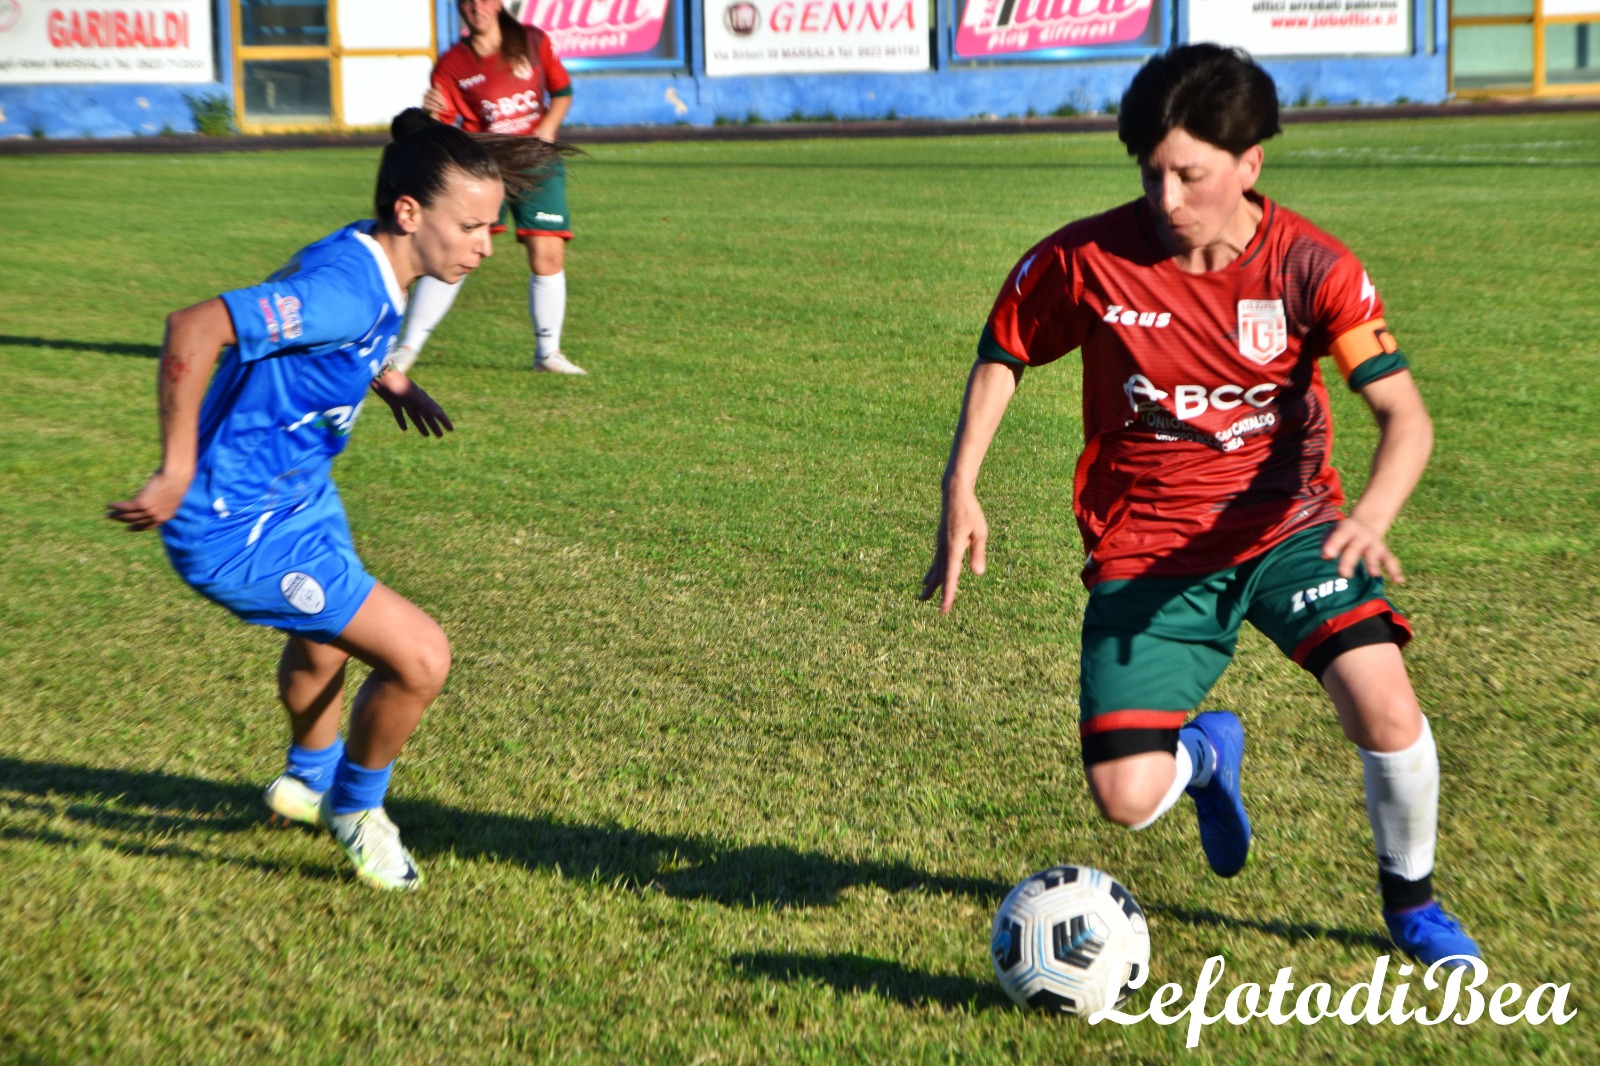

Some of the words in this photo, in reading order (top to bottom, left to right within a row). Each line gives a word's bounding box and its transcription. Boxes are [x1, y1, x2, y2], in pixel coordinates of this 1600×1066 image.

[47, 9, 189, 49] GARIBALDI
[769, 0, 916, 32] GENNA
[987, 30, 1029, 50] play
[1039, 21, 1116, 42] different
[782, 46, 835, 59] MARSALA
[497, 90, 539, 116] BCC
[1103, 304, 1172, 328] Zeus
[1175, 383, 1278, 420] BCC
[1231, 412, 1275, 436] CATALDO
